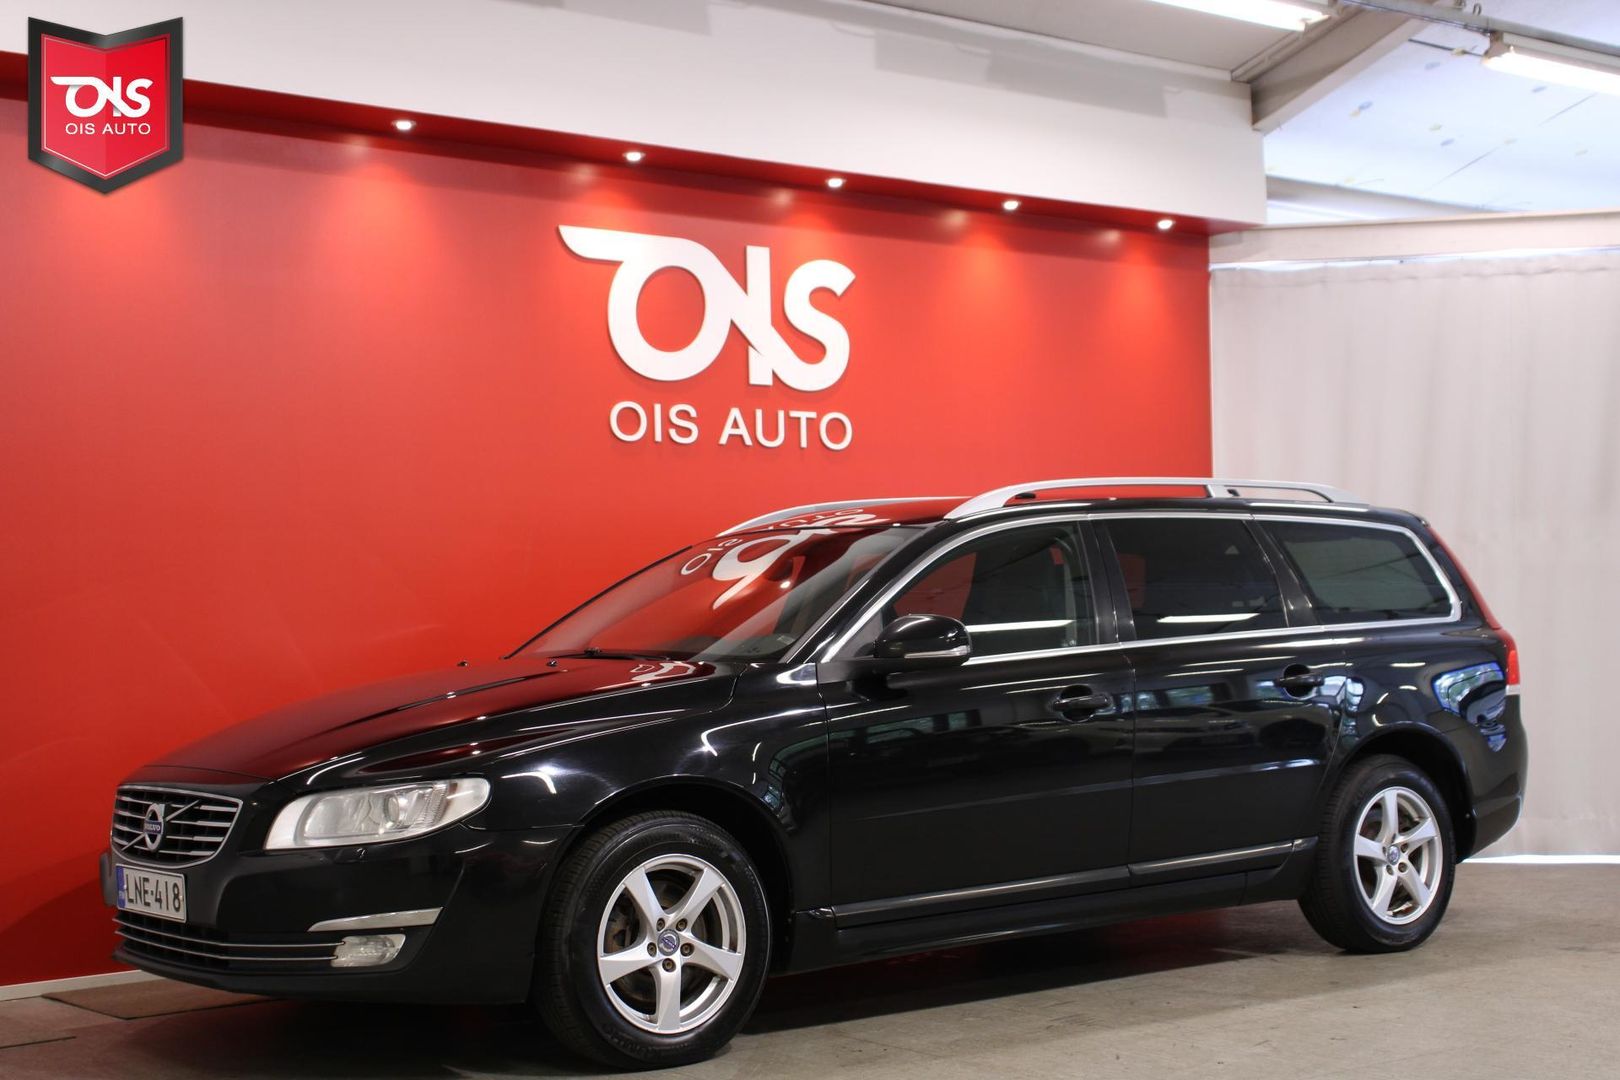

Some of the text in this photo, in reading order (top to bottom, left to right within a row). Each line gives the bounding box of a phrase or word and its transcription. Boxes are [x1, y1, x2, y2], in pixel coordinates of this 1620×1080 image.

[609, 400, 853, 451] OIS AUTO
[126, 873, 181, 912] LNE-418
